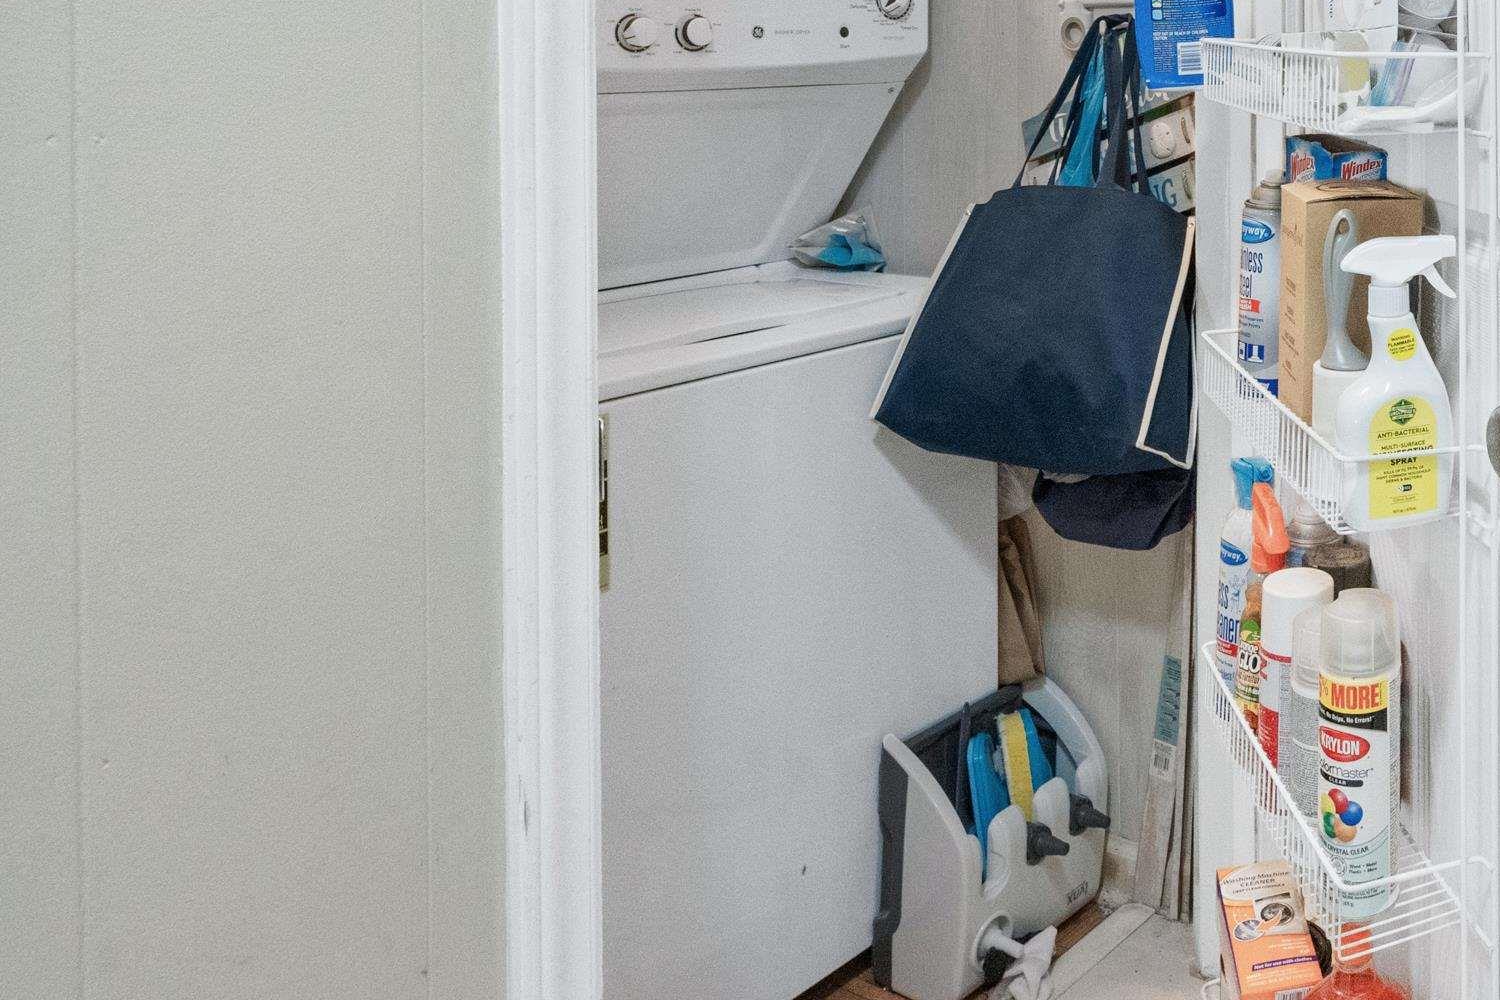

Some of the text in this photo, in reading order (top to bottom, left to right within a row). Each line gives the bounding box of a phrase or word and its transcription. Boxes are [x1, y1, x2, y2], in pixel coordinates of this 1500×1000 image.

[1341, 159, 1383, 181] Windex
[1377, 427, 1430, 439] ANTI-BACTERIAL
[1381, 440, 1426, 451] MULTI-SURFACE
[1390, 456, 1417, 466] SPRAY
[1320, 731, 1360, 756] KRYLON
[1326, 843, 1369, 856] CRYSTAL CLEAR
[1240, 878, 1276, 887] CLEANER
